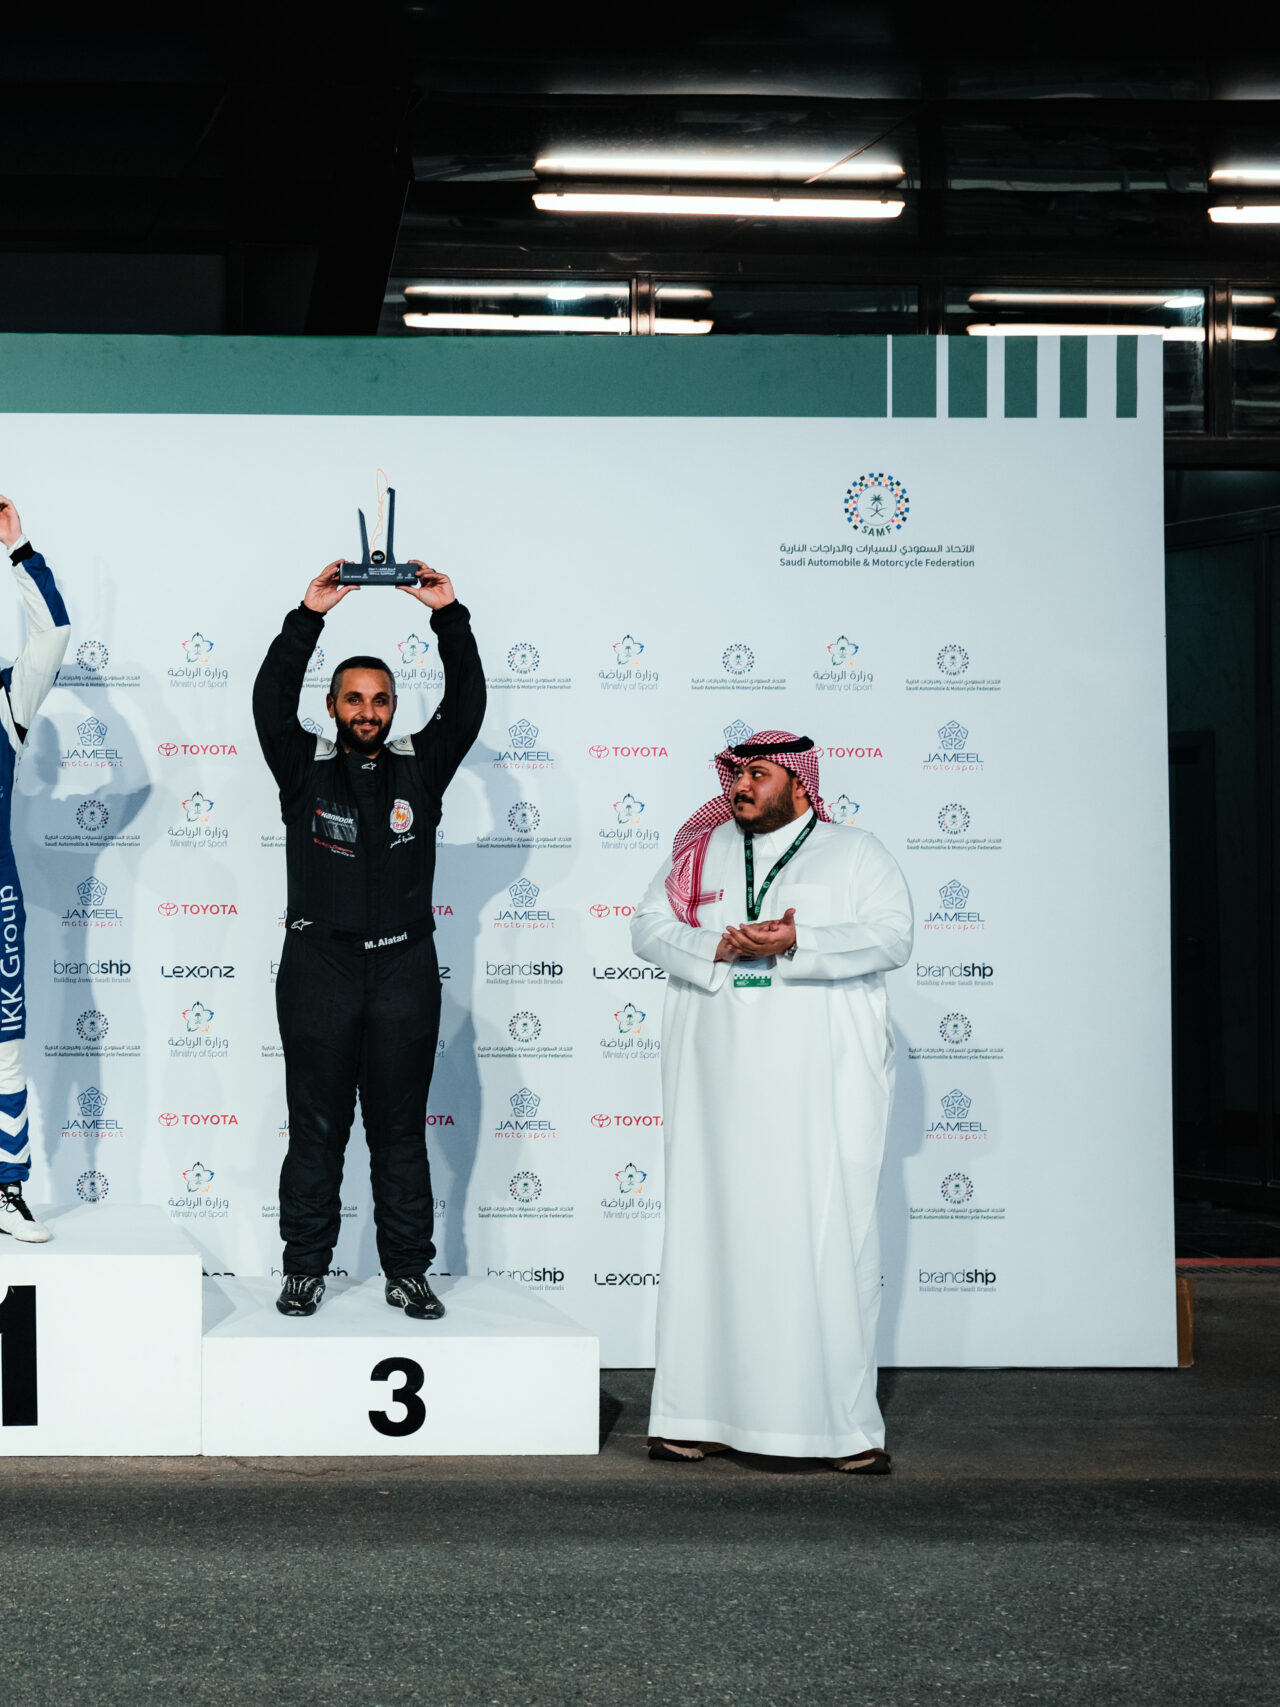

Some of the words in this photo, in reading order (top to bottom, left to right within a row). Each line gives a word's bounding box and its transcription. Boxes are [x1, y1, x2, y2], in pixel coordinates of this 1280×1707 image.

[862, 524, 893, 536] SAMF
[779, 543, 807, 554] النارية
[810, 543, 853, 554] والدراجات
[855, 543, 897, 554] للسيارات
[899, 543, 943, 554] السعودي
[779, 558, 805, 567] Saudi
[808, 558, 861, 567] Automobile
[862, 558, 870, 567] &
[872, 558, 923, 568] Motorcycle
[925, 558, 975, 567] Federation
[168, 667, 201, 678] الرياضة
[205, 667, 228, 679] وزارة
[598, 669, 631, 680] الرياضة
[636, 669, 658, 681] وزارة
[813, 670, 846, 681] الرياضة
[850, 670, 873, 682] وزارة
[62, 749, 123, 759] JAMEEL
[181, 744, 237, 755] TOYOTA
[612, 746, 668, 757] TOYOTA
[827, 747, 883, 758] TOYOTA
[493, 751, 554, 761] JAMEEL
[923, 752, 984, 763] JAMEEL
[62, 760, 124, 768] motorsport
[493, 762, 555, 770] motorsport
[922, 764, 985, 772] motorsport
[168, 826, 201, 838] الرياضة
[205, 826, 228, 839] وزارة
[599, 828, 632, 839] الرياضة
[636, 828, 659, 840] وزارة
[62, 908, 123, 919] JAMEEL
[181, 904, 238, 915] TOYOTA
[494, 910, 555, 920] JAMEEL
[924, 912, 985, 922] JAMEEL
[62, 920, 124, 928] motorsport
[0, 885, 21, 978] Group
[364, 941, 377, 950] M.
[378, 931, 408, 948] Alatari
[1, 984, 23, 1032] IKK
[168, 1036, 201, 1048] الرياضة
[206, 1036, 228, 1049] وزارة
[600, 1038, 633, 1049] الرياضة
[638, 1038, 660, 1050] وزارة
[62, 1119, 123, 1129] JAMEEL
[182, 1114, 238, 1125] TOYOTA
[495, 1120, 556, 1130] JAMEEL
[926, 1121, 987, 1132] JAMEEL
[168, 1197, 201, 1208] الرياضة
[206, 1197, 228, 1209] وزارة
[601, 1198, 634, 1209] الرياضة
[638, 1198, 661, 1210] وزارة
[368, 1357, 426, 1437] 3
